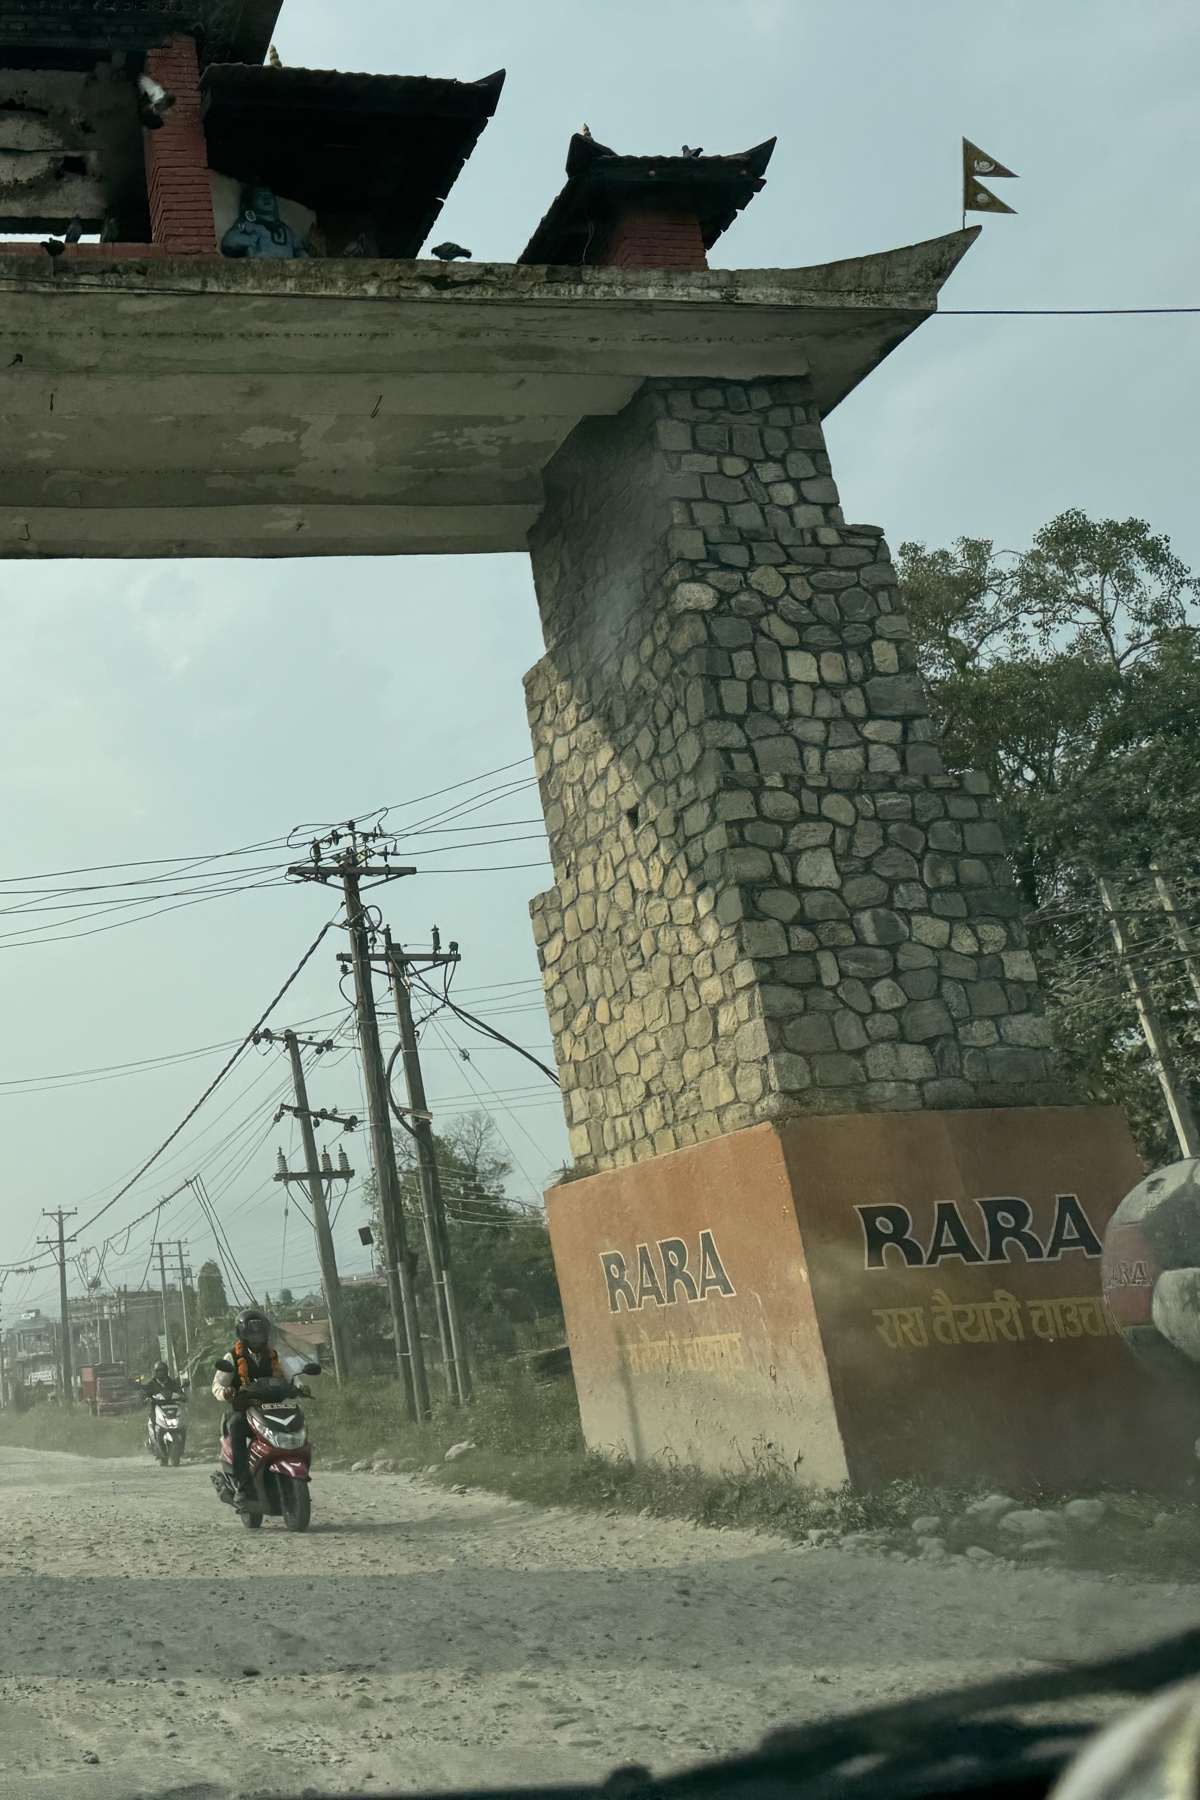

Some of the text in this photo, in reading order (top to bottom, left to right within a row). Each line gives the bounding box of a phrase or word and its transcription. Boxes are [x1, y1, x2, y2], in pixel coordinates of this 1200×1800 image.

[599, 1228, 737, 1314] RARA
[853, 1193, 1104, 1271] RARA
[872, 1289, 1119, 1349] रारा तैयारी चाउचा
